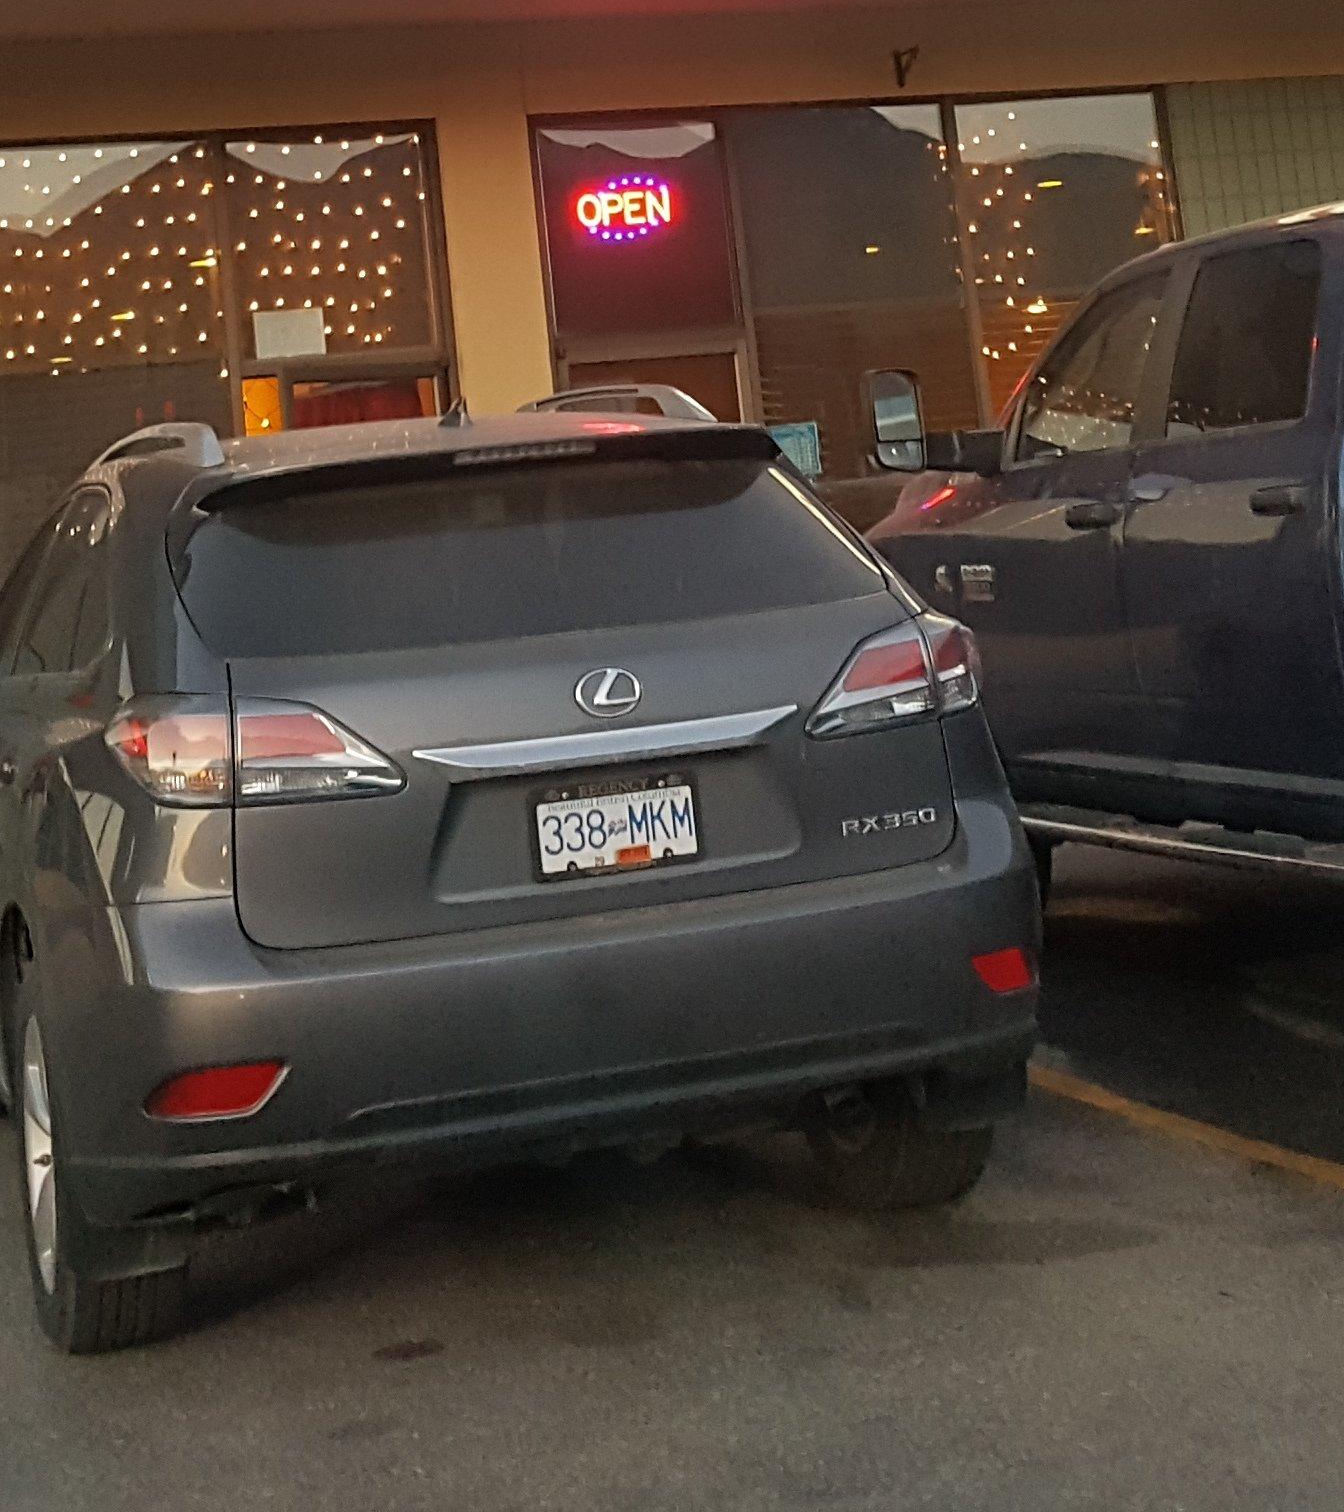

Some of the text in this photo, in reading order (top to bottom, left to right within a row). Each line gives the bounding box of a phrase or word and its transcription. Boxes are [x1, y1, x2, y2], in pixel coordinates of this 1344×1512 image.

[577, 185, 671, 227] OPEN
[542, 797, 693, 855] 338 MKM
